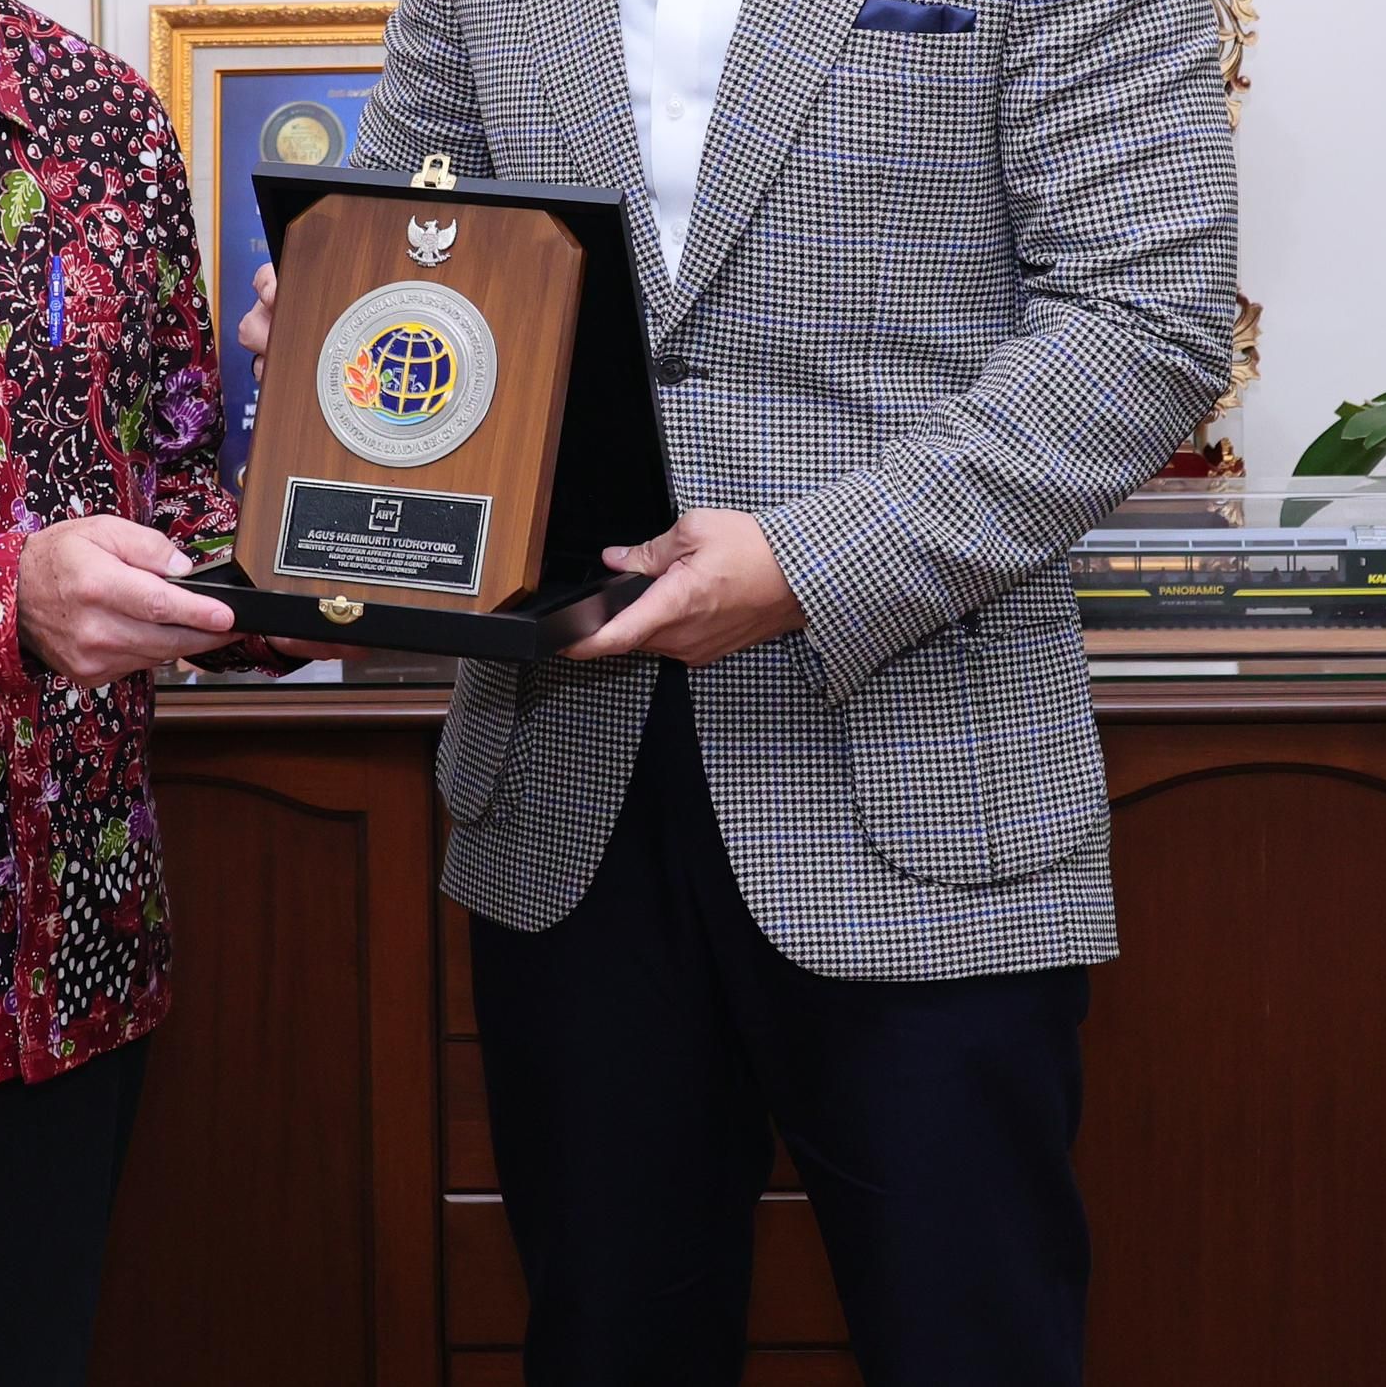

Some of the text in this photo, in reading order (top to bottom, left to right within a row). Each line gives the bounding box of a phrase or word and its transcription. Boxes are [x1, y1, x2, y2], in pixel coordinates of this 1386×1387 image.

[376, 509, 396, 521] AHY
[308, 529, 456, 554] AGUS HARIMURTI YUDHOYONO
[1158, 585, 1225, 596] PANORAMIC
